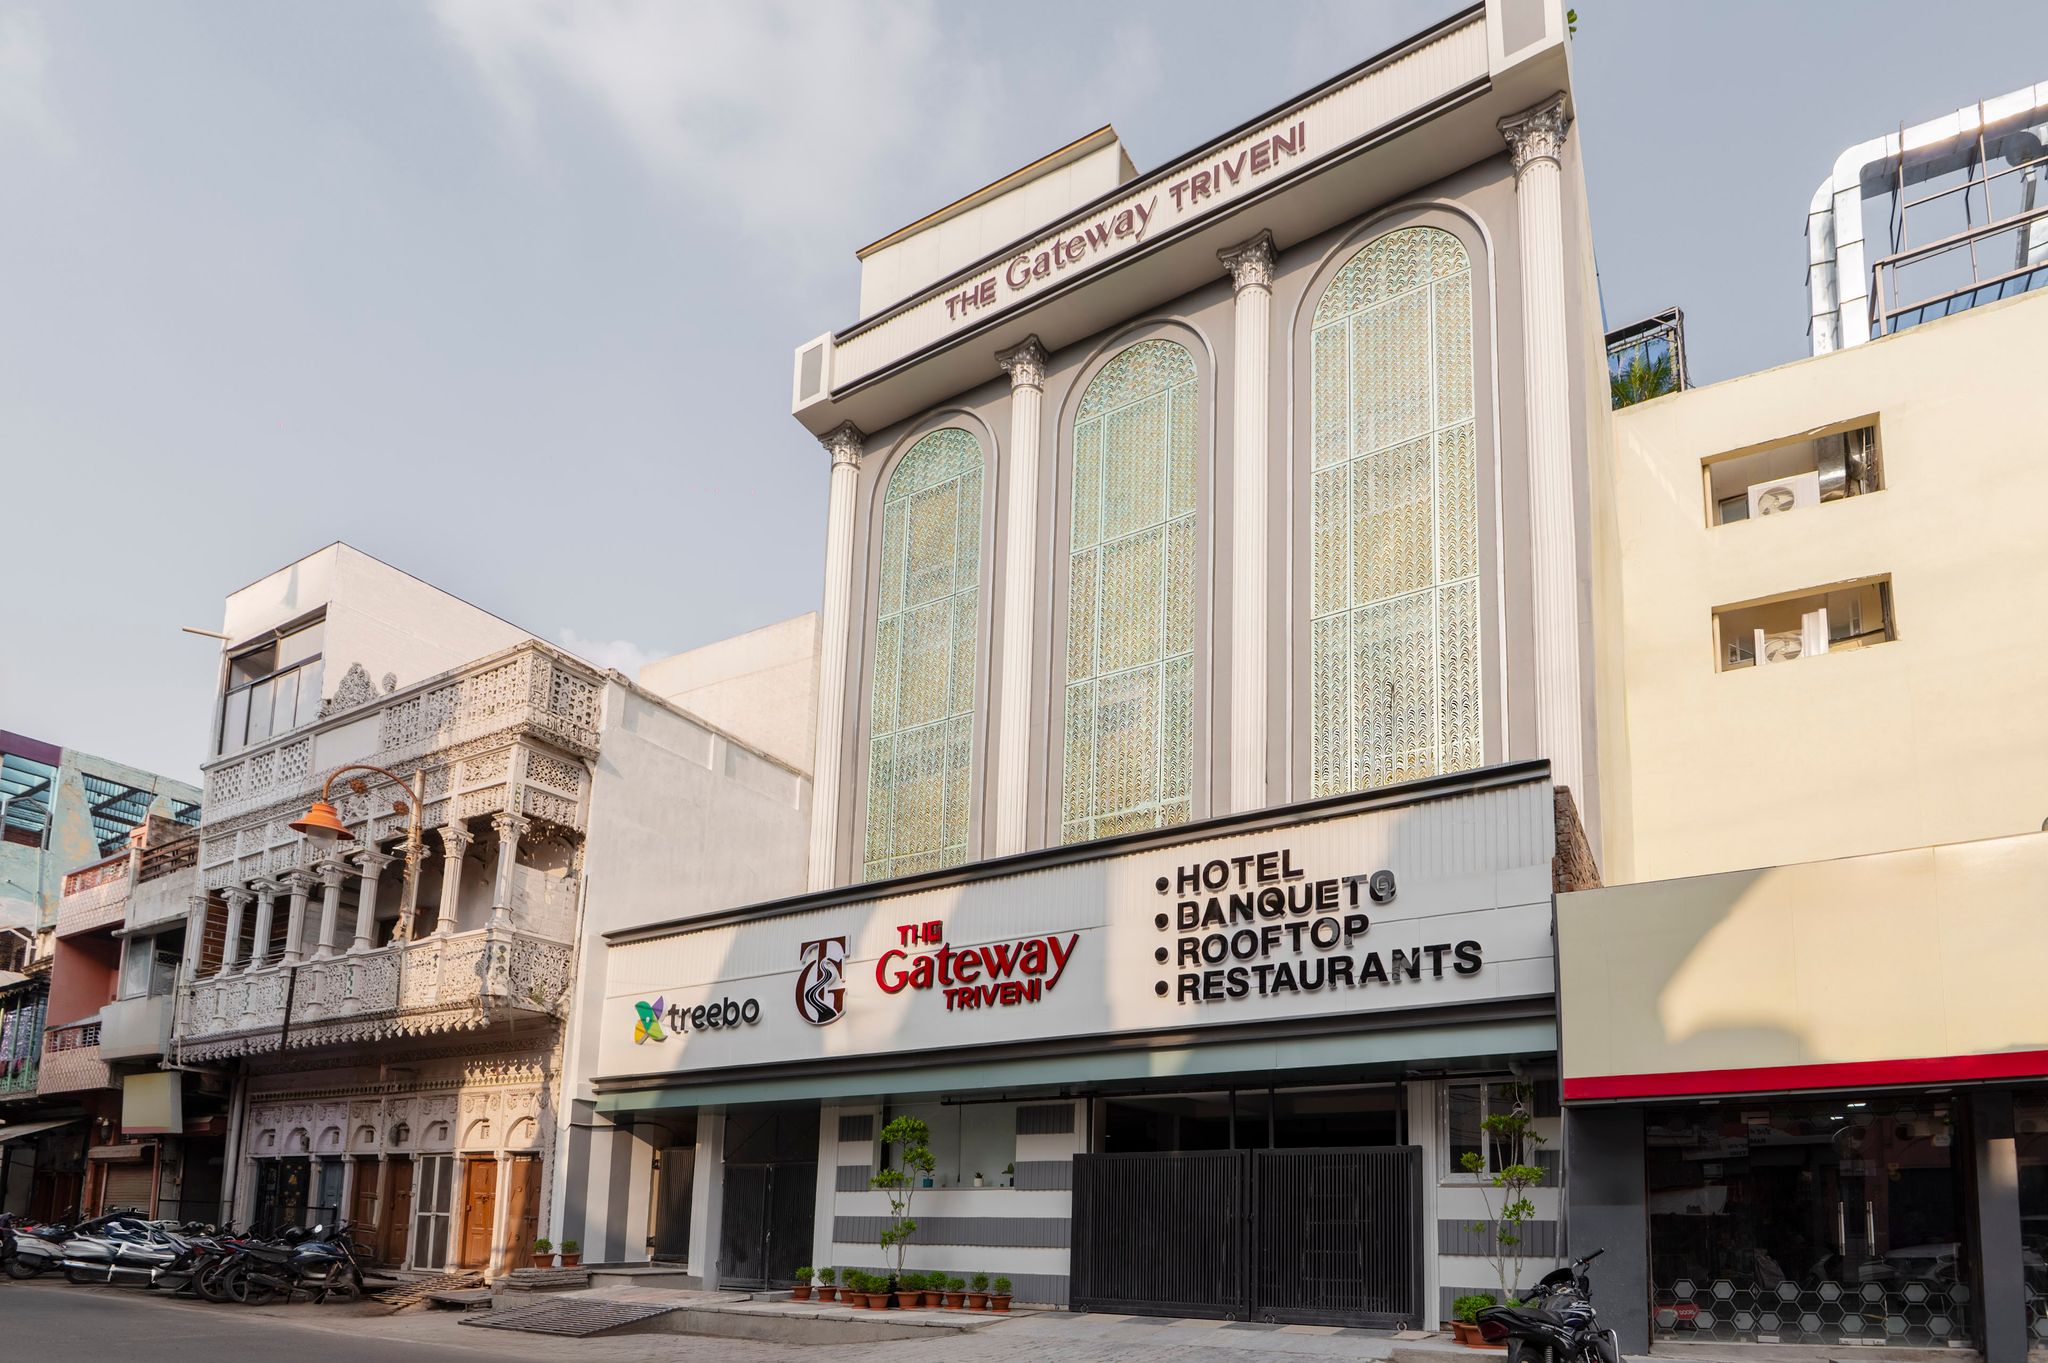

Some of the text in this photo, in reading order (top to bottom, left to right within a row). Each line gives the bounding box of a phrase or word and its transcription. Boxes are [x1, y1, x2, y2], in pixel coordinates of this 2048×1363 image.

[945, 121, 1305, 320] THE Gateway TRIVENI
[1176, 849, 1305, 895] HOTEL
[876, 933, 1080, 995] Gateway
[1177, 914, 1371, 967] ROOFTOP
[943, 977, 1043, 1012] TRIVENI
[1177, 940, 1483, 1003] RESTAURANTS
[667, 996, 762, 1034] treebo
